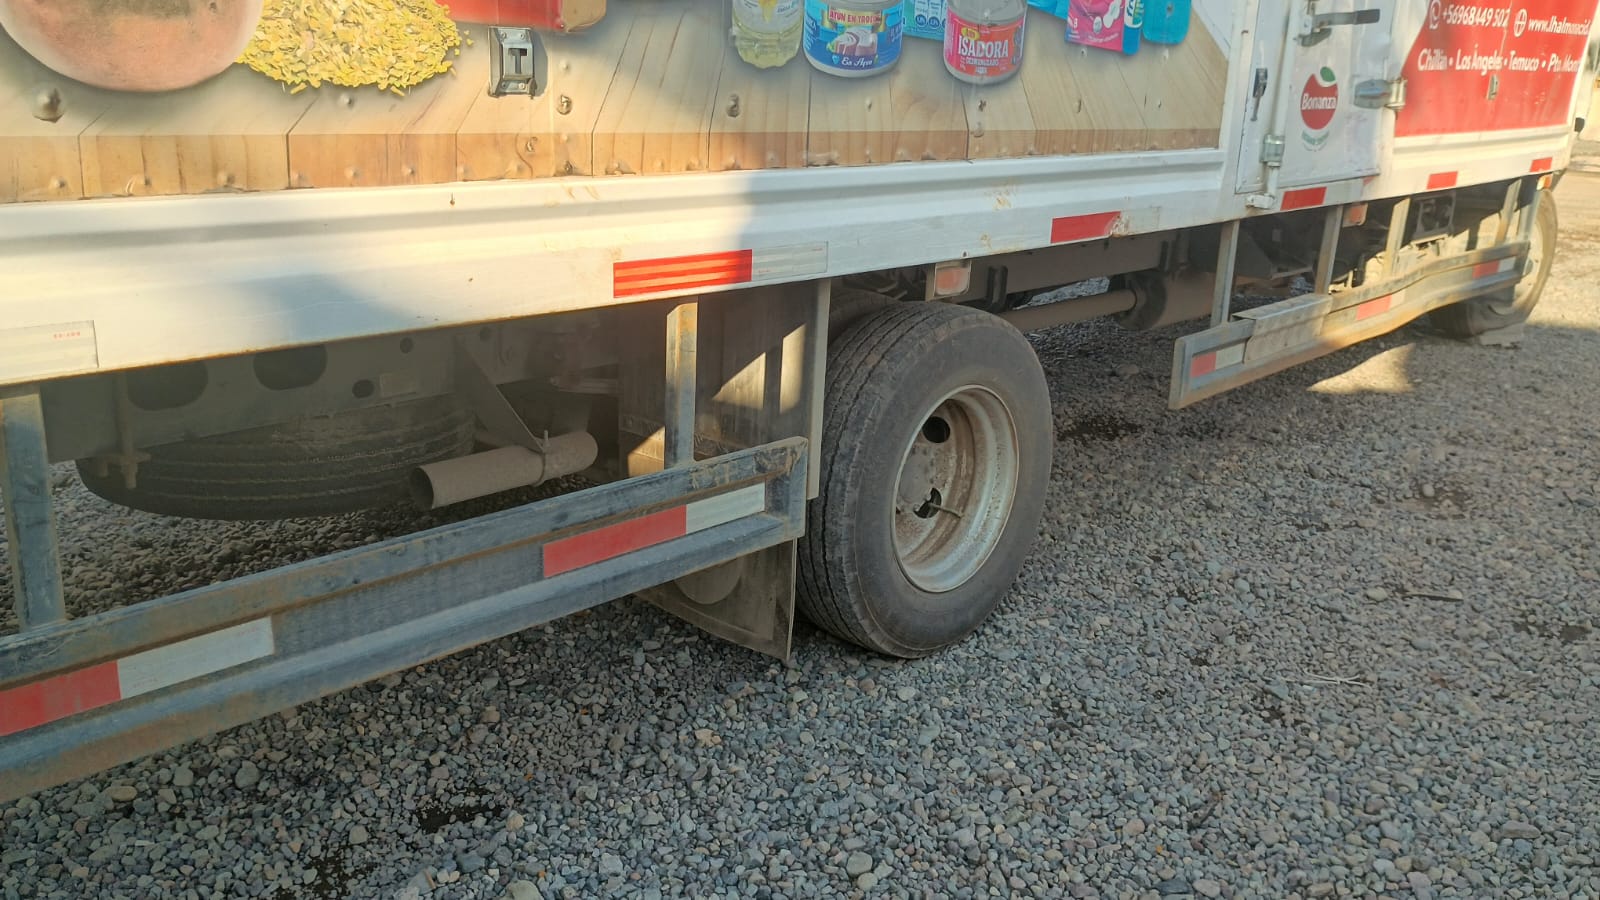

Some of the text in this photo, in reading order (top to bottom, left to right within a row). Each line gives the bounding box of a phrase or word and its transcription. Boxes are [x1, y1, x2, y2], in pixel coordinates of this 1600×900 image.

[958, 34, 1009, 58] ISADORA
[1455, 48, 1471, 71] Los
[1508, 50, 1539, 71] Temuco
[1301, 93, 1336, 110] Bonanza
